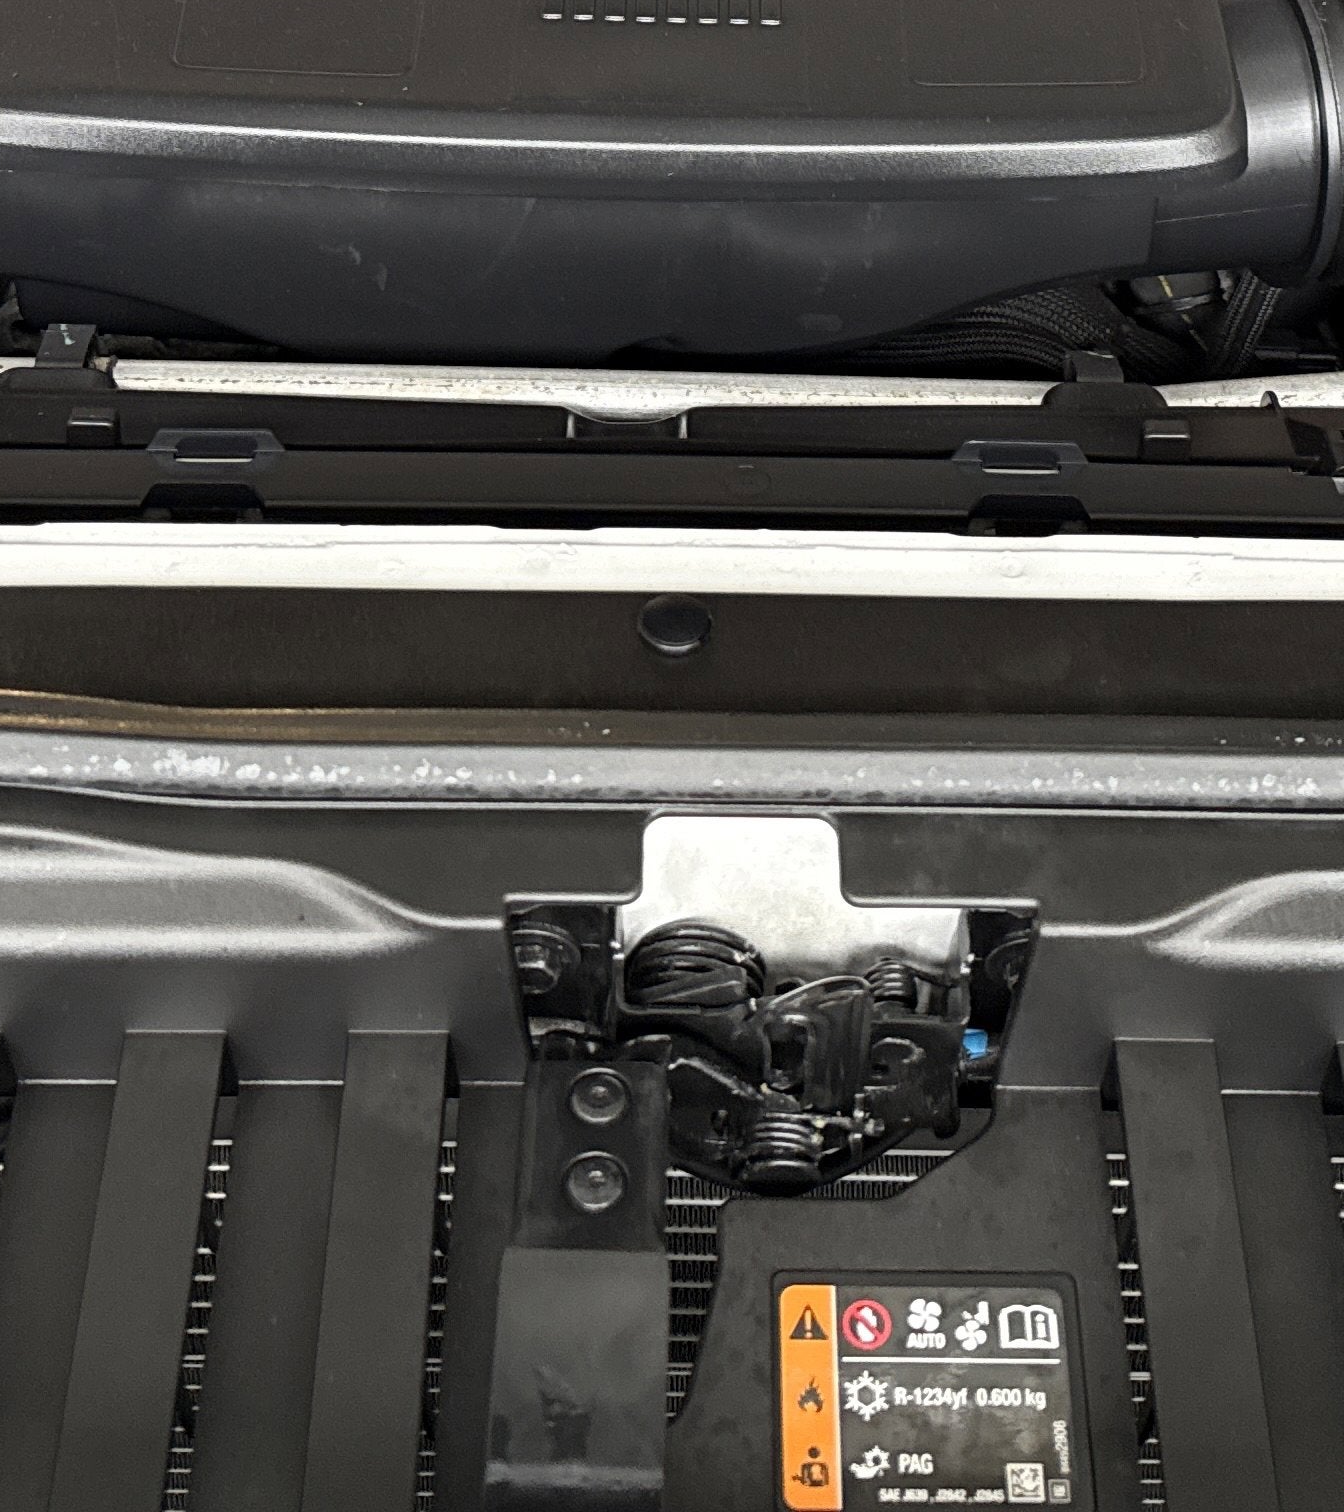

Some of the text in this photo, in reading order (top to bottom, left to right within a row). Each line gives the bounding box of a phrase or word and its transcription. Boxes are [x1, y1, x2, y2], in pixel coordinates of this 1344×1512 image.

[906, 1333, 946, 1349] AUTO
[894, 1387, 1047, 1410] R-1234yf 0.600 kg
[898, 1453, 934, 1475] PAG
